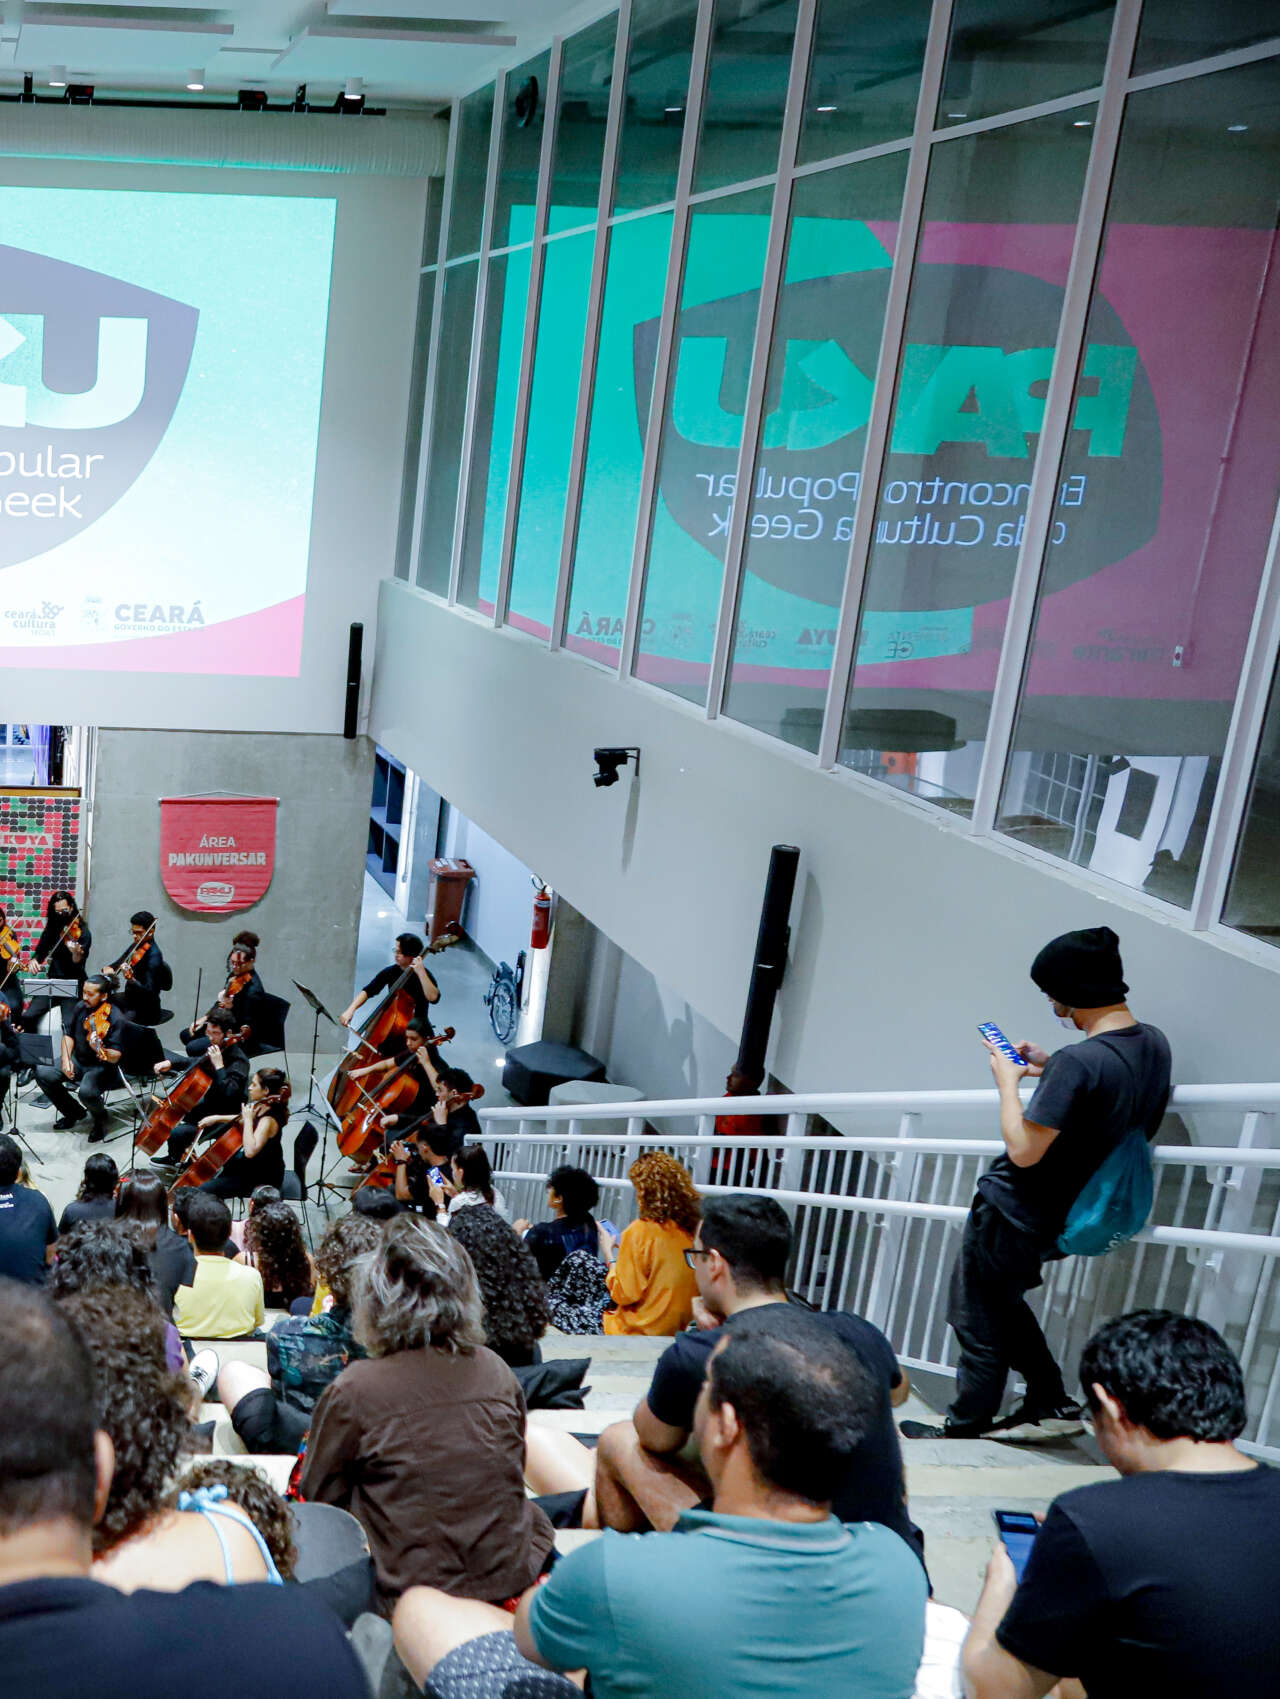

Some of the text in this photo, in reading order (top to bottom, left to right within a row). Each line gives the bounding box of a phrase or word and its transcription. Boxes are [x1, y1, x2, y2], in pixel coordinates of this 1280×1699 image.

[114, 600, 205, 625] CEARÁ
[3, 834, 49, 846] KUYA
[199, 833, 236, 848] ÁREA
